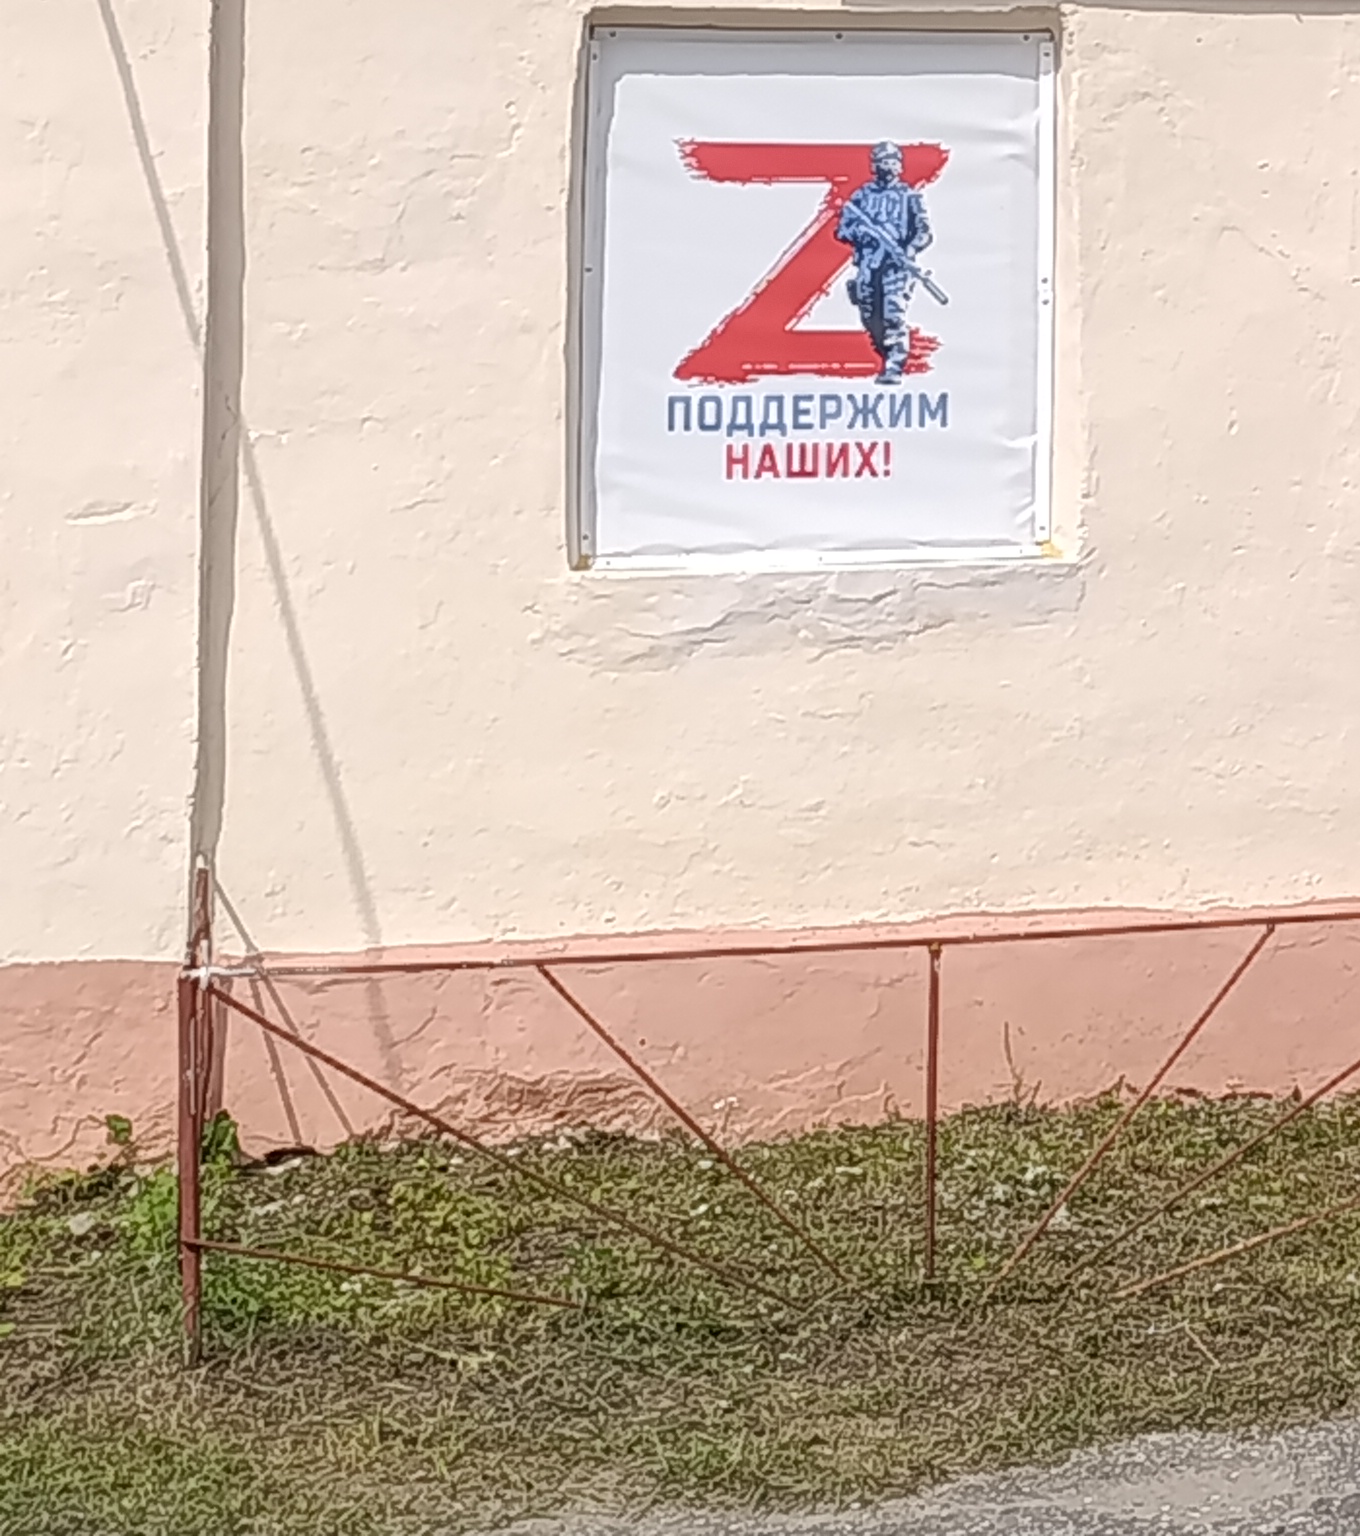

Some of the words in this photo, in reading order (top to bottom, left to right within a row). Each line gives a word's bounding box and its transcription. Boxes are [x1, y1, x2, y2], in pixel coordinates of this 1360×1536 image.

[673, 138, 951, 386] Z
[667, 392, 949, 438] ПОДДЕРЖИМ
[725, 441, 893, 480] НАШИХ!
